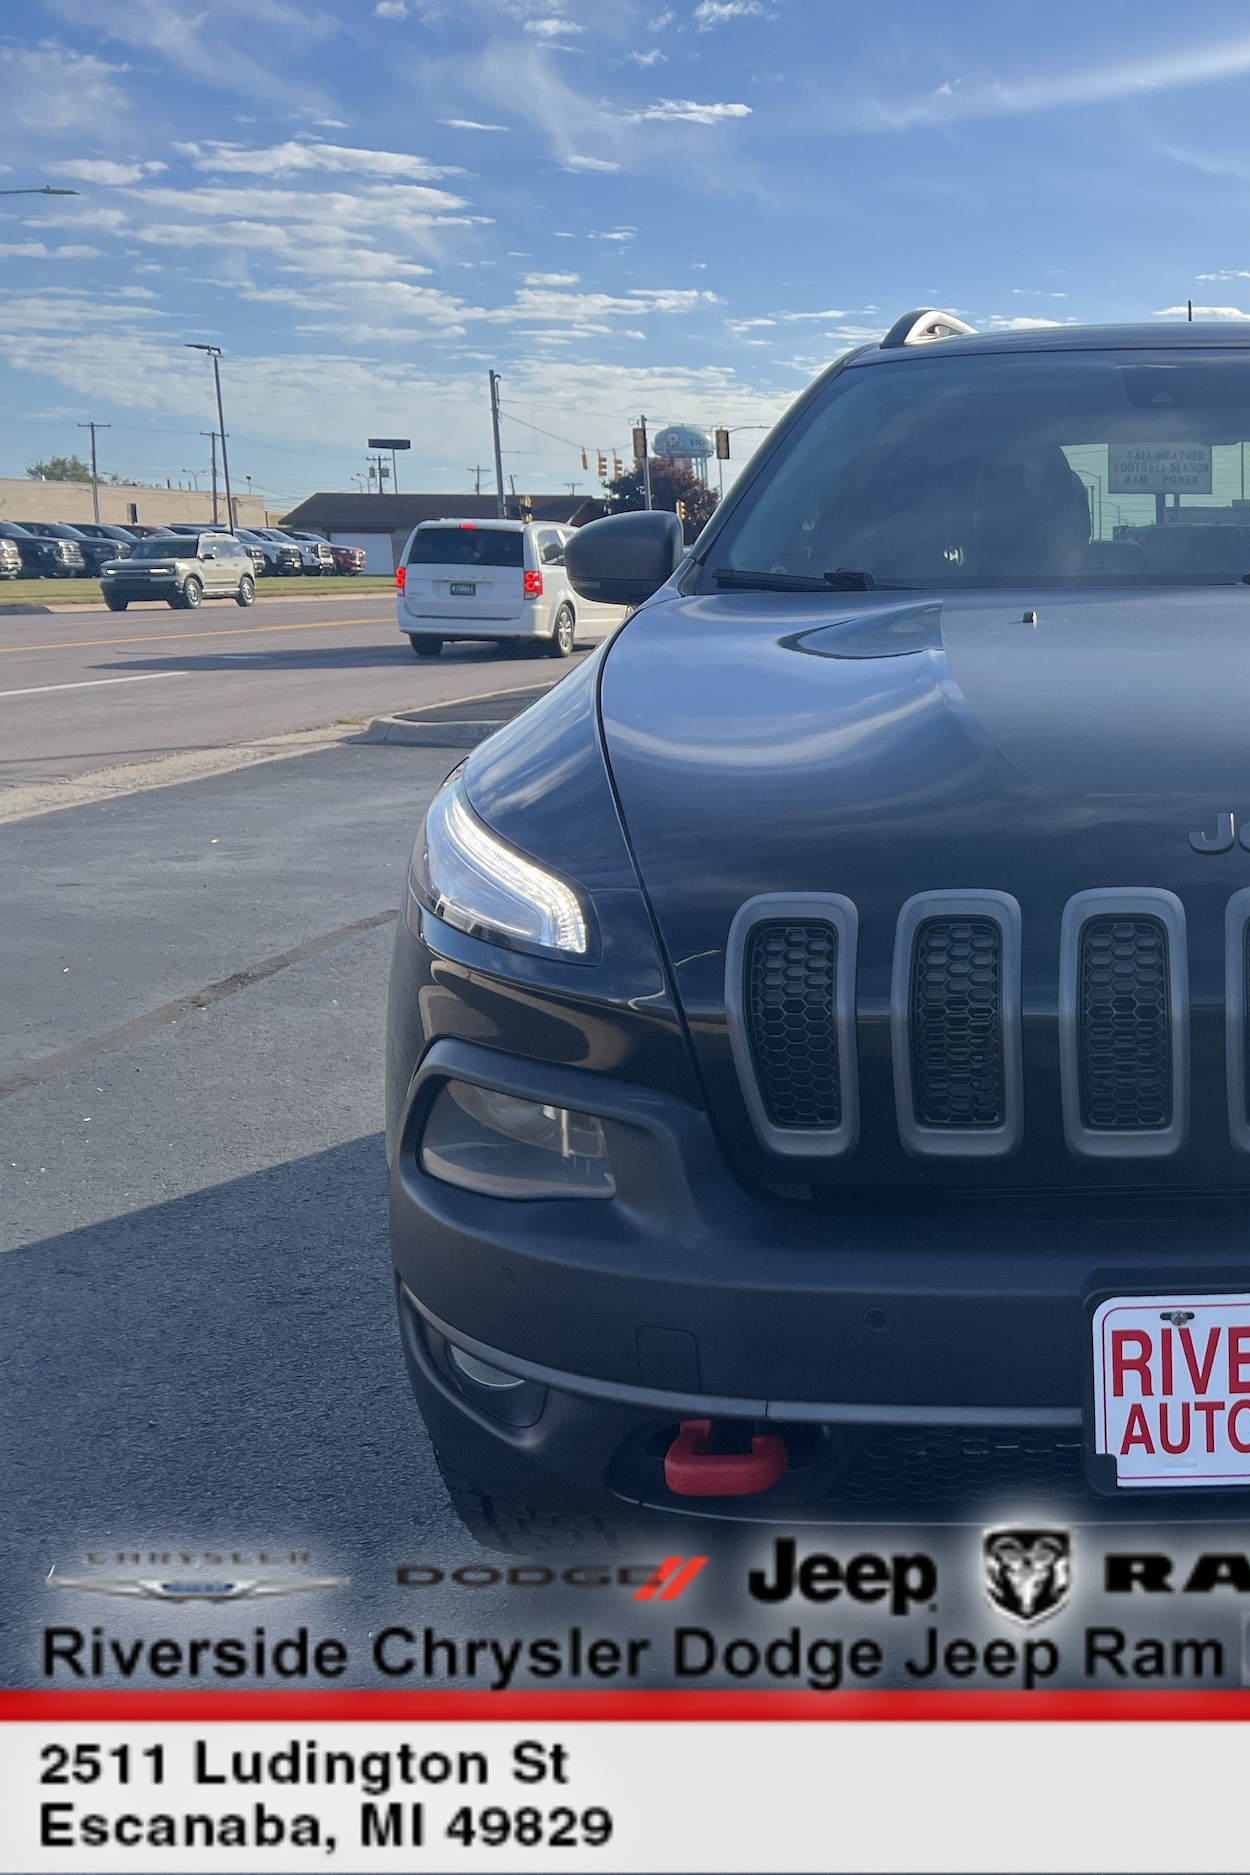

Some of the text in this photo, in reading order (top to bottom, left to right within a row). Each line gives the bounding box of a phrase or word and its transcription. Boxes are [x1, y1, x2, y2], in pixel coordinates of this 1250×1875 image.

[1127, 450, 1205, 461] FALL WEATHER
[1113, 462, 1209, 473] FOOTBALL SEASON
[1125, 474, 1199, 485] RAM POWER
